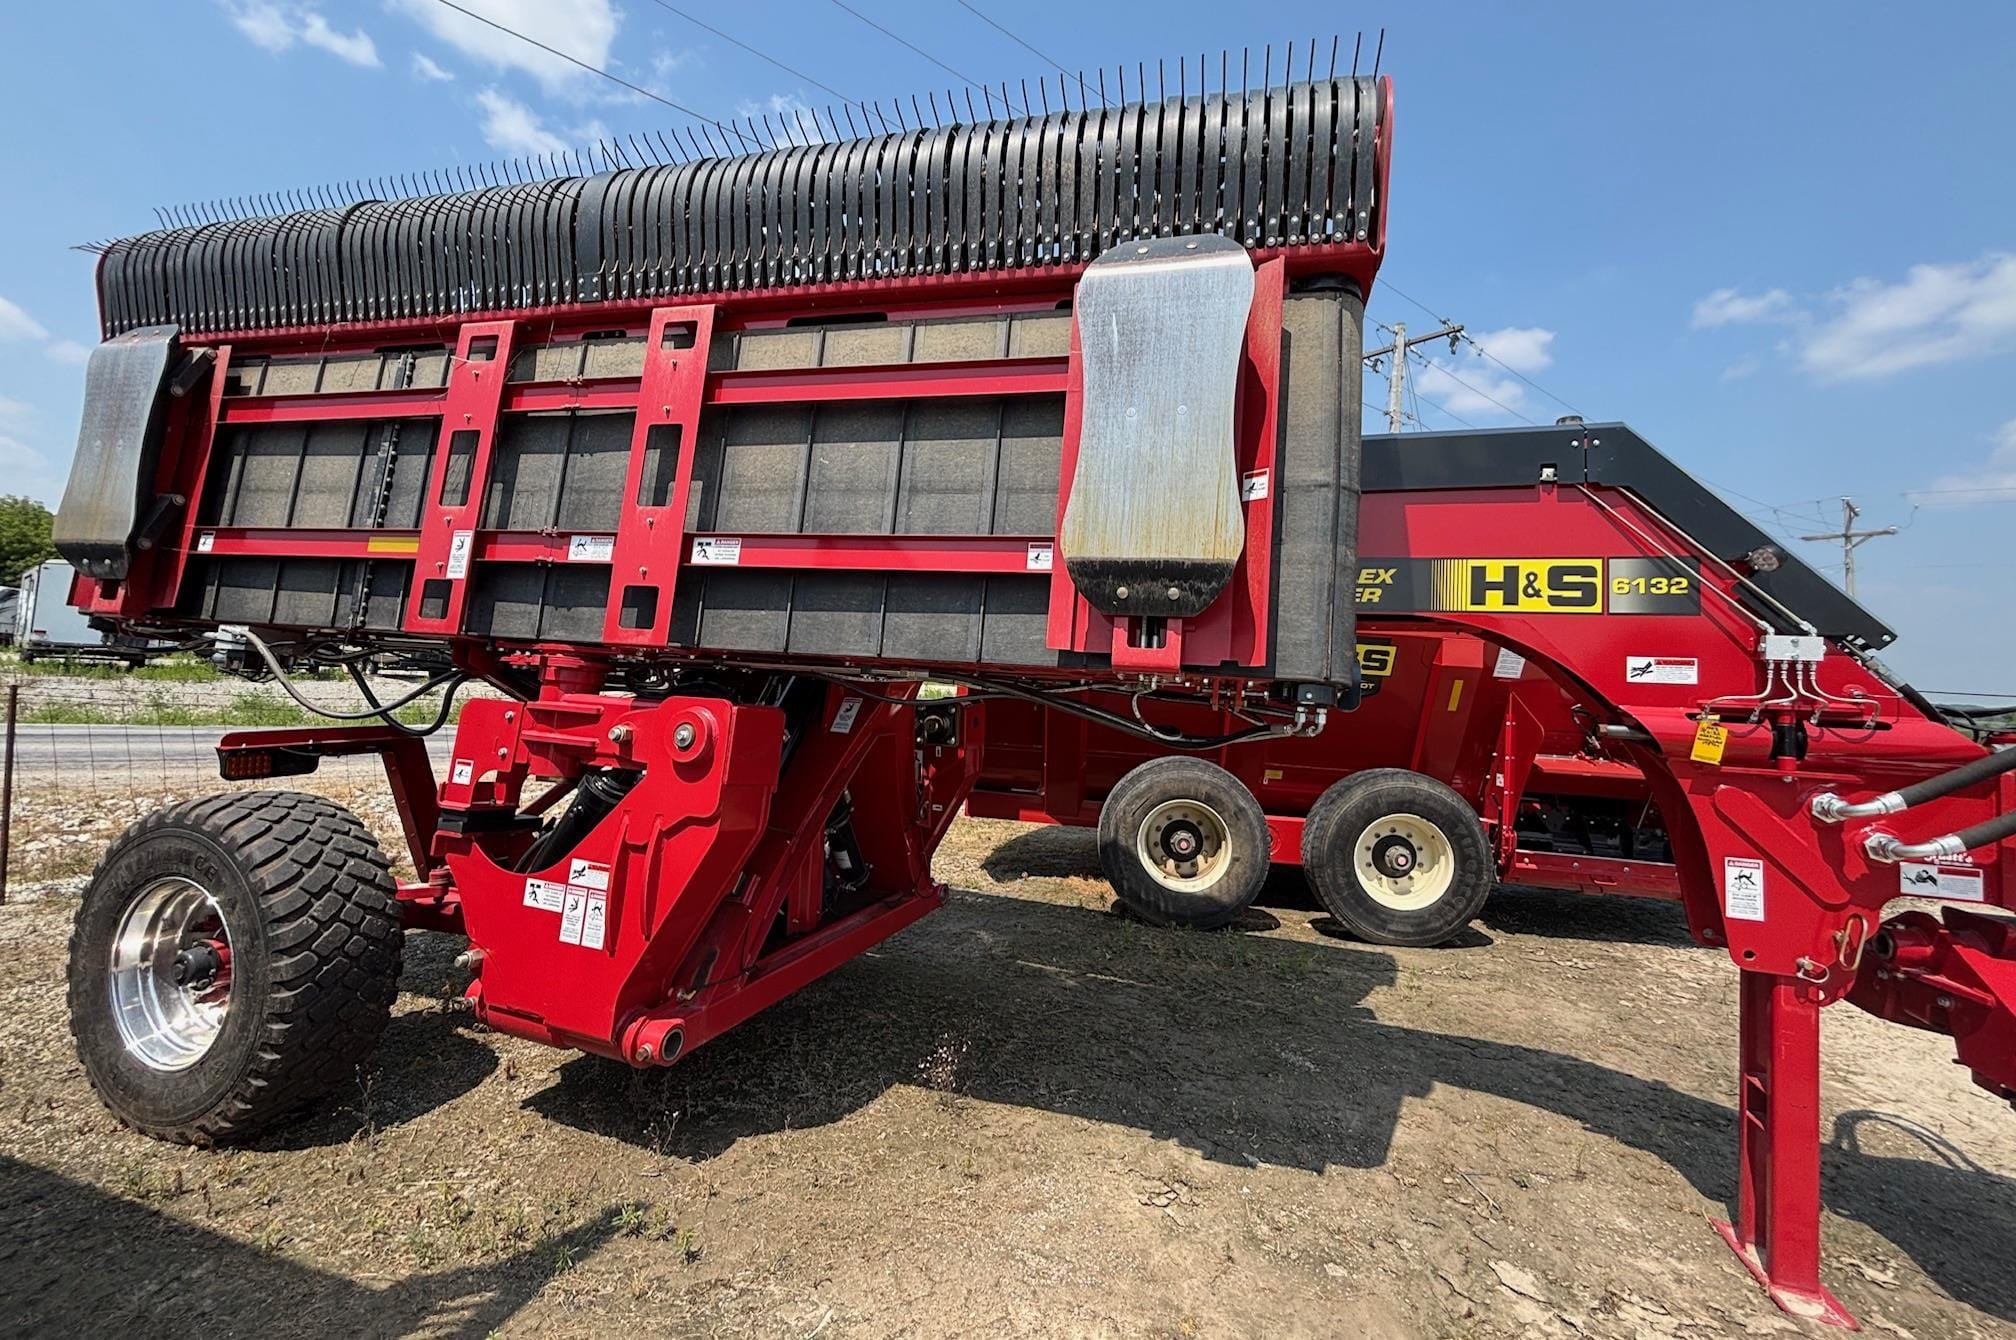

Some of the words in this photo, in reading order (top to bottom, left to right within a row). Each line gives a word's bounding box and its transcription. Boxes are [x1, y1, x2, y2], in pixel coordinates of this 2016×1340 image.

[1357, 568, 1398, 585] EX
[1470, 565, 1597, 607] H&S
[1612, 577, 1689, 594] 6132
[1357, 649, 1391, 672] S
